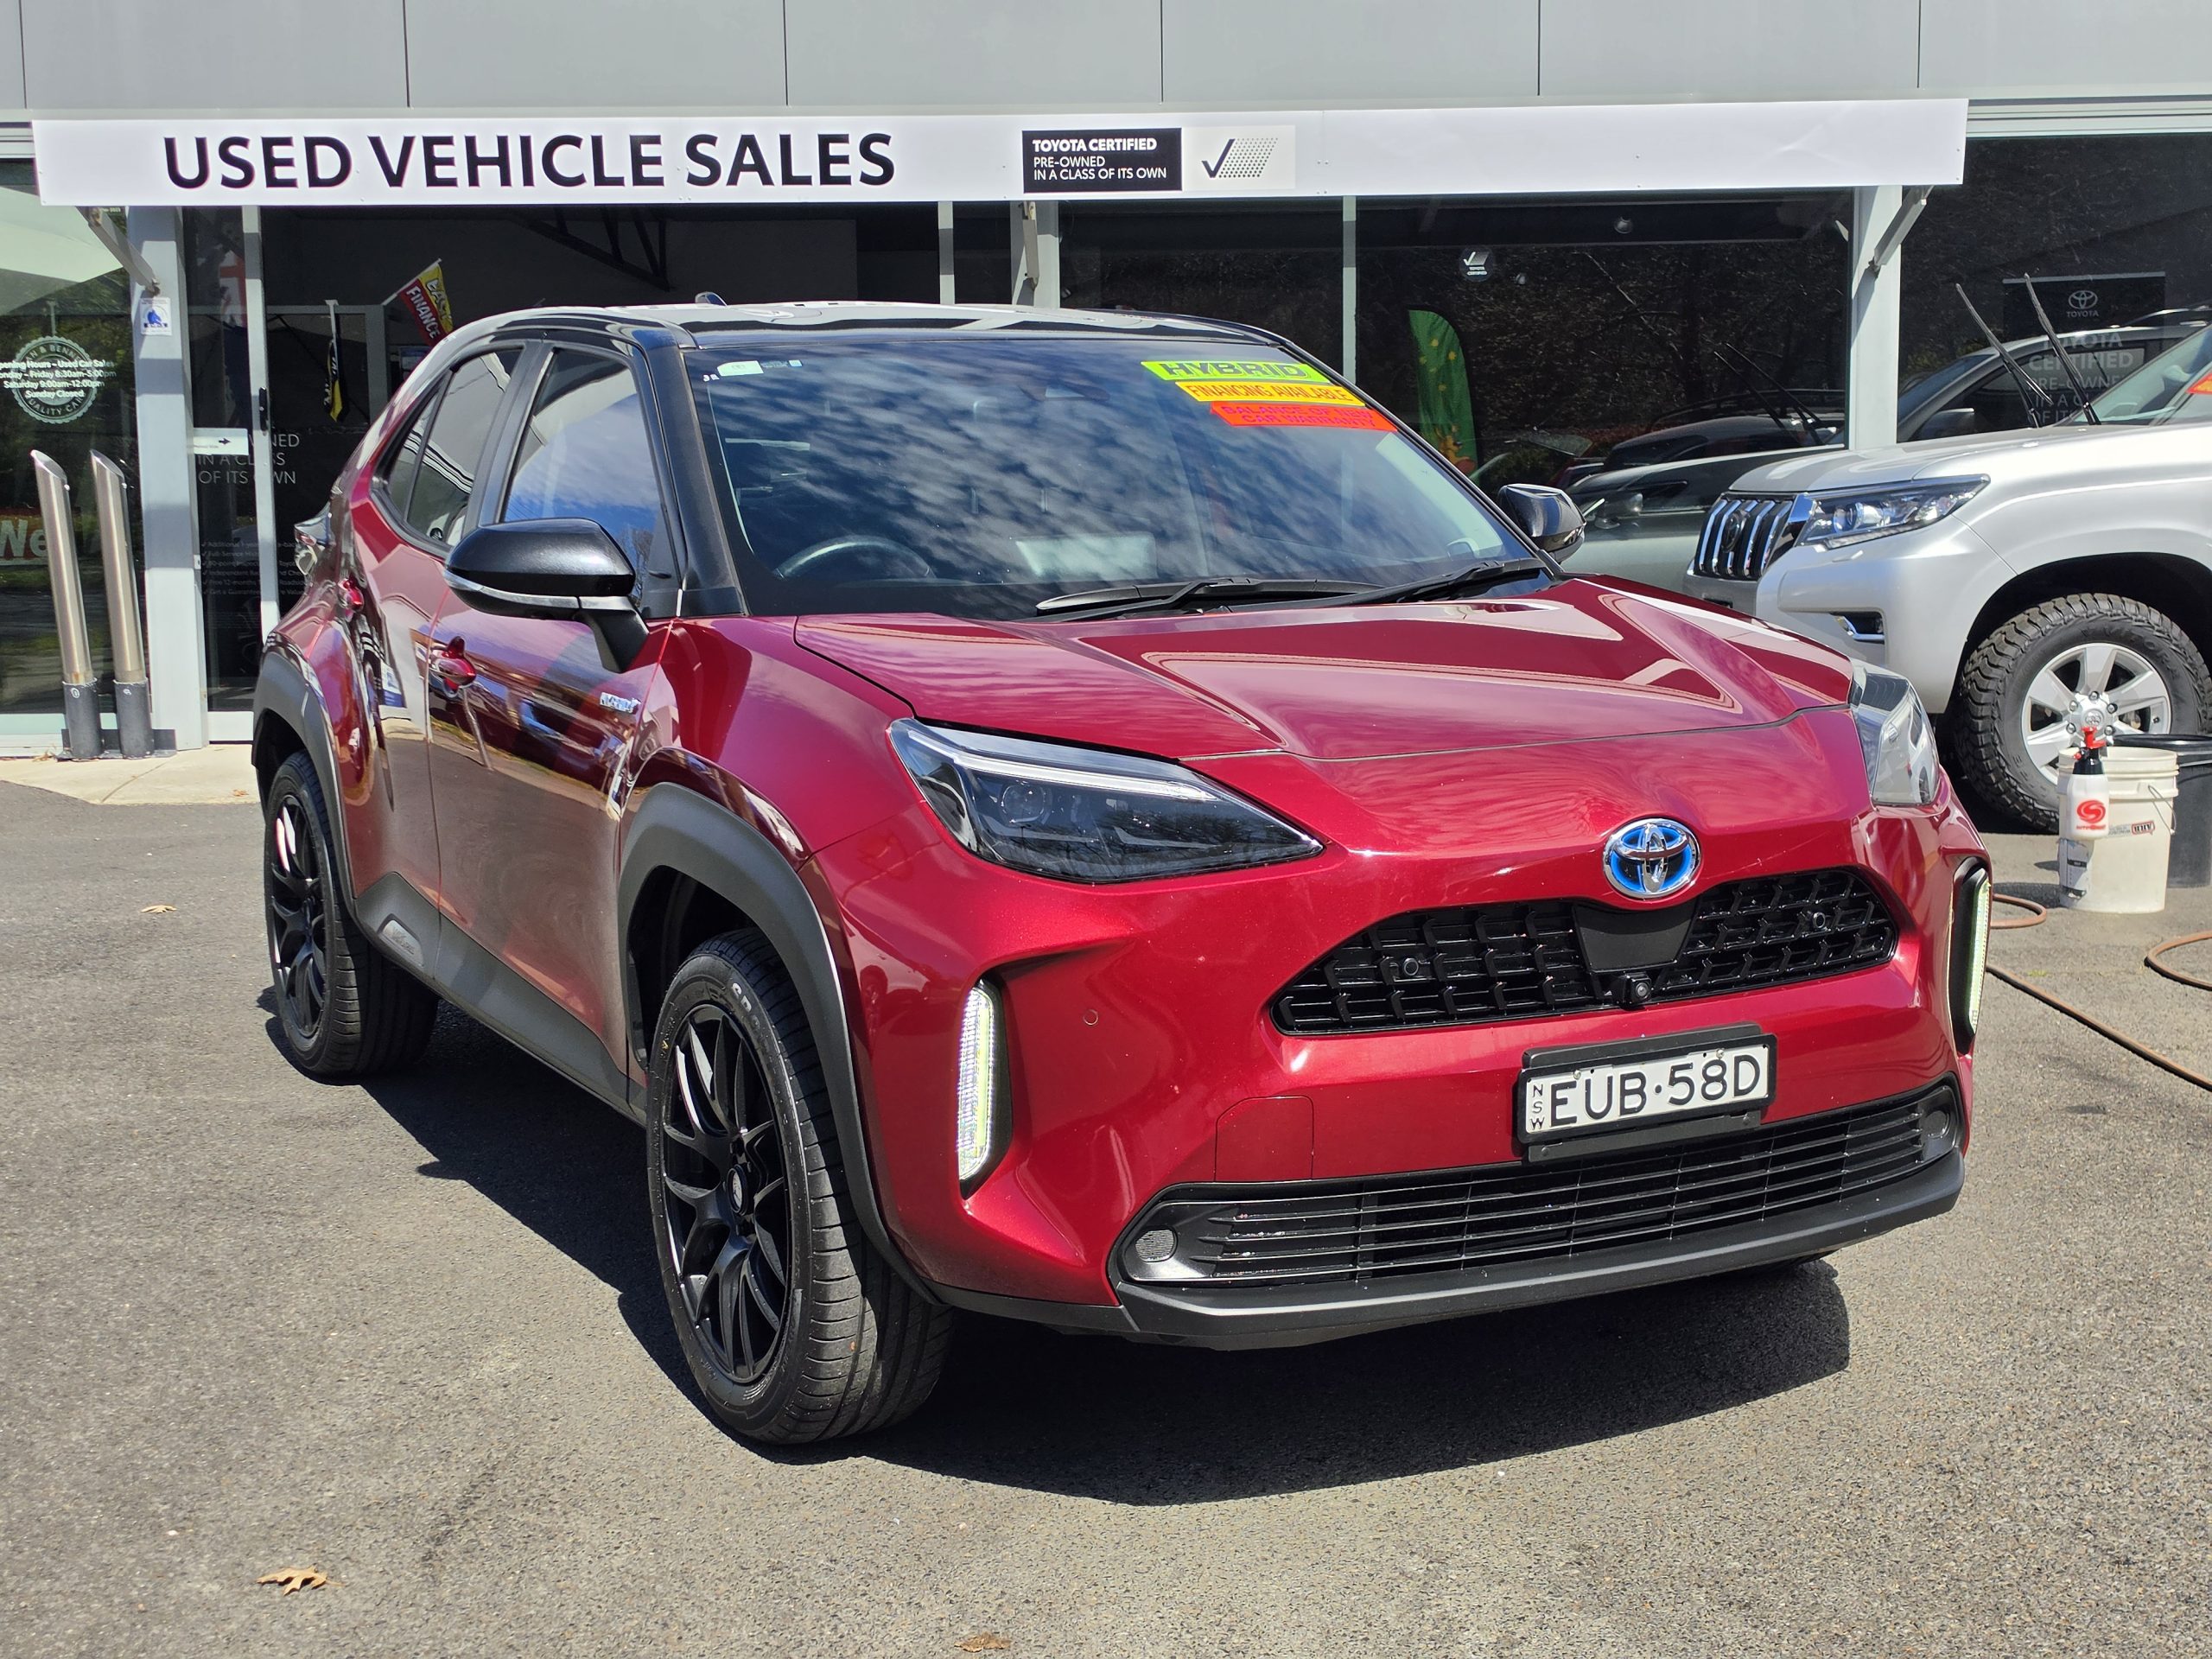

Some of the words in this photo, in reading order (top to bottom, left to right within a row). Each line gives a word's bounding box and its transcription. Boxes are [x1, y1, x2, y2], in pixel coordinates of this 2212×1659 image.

[1033, 139, 1087, 152] TOYOTA
[1088, 138, 1158, 151] CERTIFIED
[164, 136, 353, 188] USED
[367, 134, 664, 188] VEHICLE
[685, 133, 895, 187] SALES
[1033, 156, 1105, 168] PRE-OWNED
[1033, 169, 1046, 180] IN
[1048, 169, 1058, 180] A
[1059, 168, 1096, 180] CLASS
[1097, 168, 1116, 179] OF
[1117, 168, 1134, 179] ITS
[1136, 168, 1166, 179] OWN
[406, 286, 441, 339] FINANCE
[2066, 310, 2100, 319] TOYOTA
[1160, 362, 1307, 378] HYBRID
[1185, 385, 1271, 398] FINANCING
[1272, 385, 1354, 402] AVAILABLE
[198, 454, 214, 466] IN
[219, 454, 230, 466] A
[199, 470, 221, 484] OF
[226, 470, 249, 484] ITS
[1530, 1084, 1545, 1130] NSW
